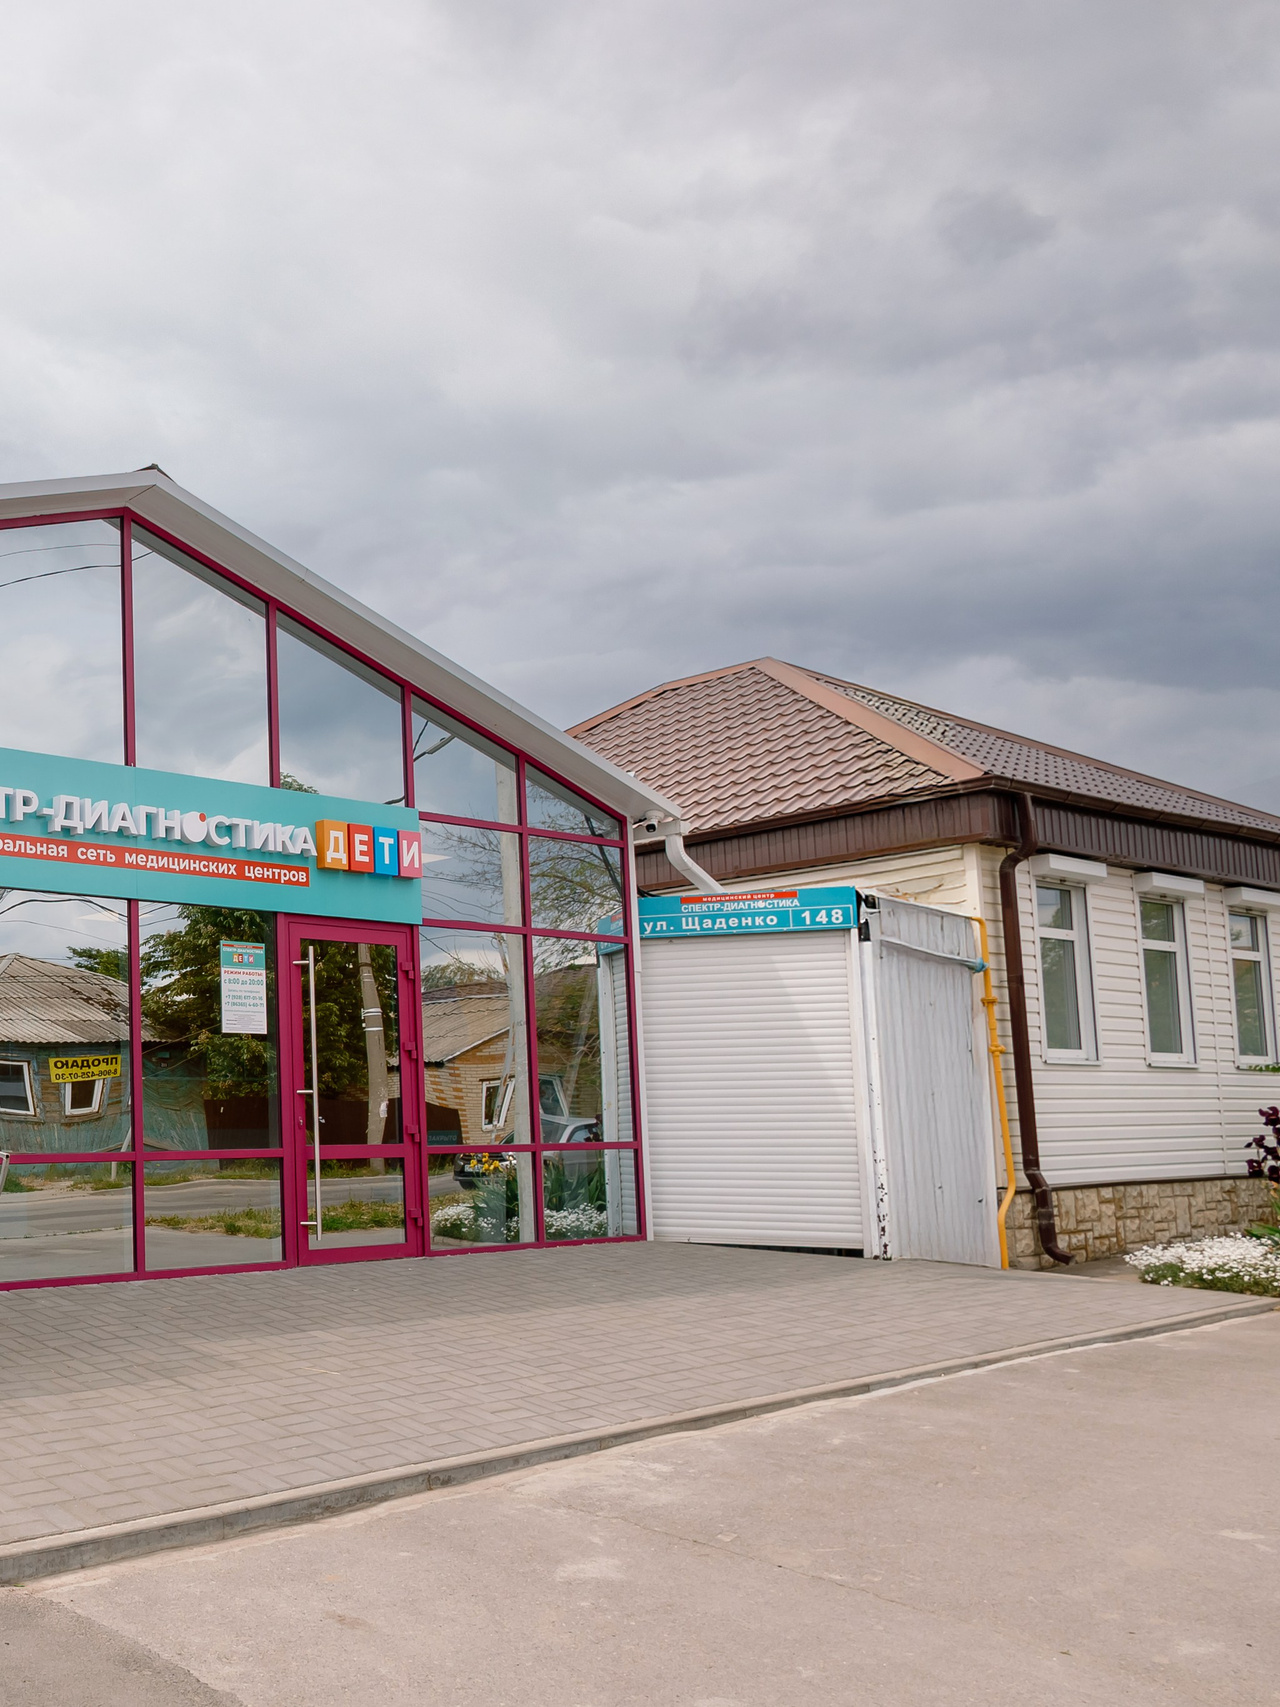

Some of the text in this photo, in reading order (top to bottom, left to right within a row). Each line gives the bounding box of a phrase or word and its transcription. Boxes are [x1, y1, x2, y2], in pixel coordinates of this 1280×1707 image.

[323, 830, 420, 870] ДЕТИ
[76, 844, 117, 865] сеть
[123, 850, 238, 876] медицинских
[243, 863, 308, 884] центров
[681, 899, 801, 912] СПЕКТР-ДИАГНОСТИКА
[703, 894, 751, 902] медицинский
[643, 909, 844, 934] ул. Щаденко 148
